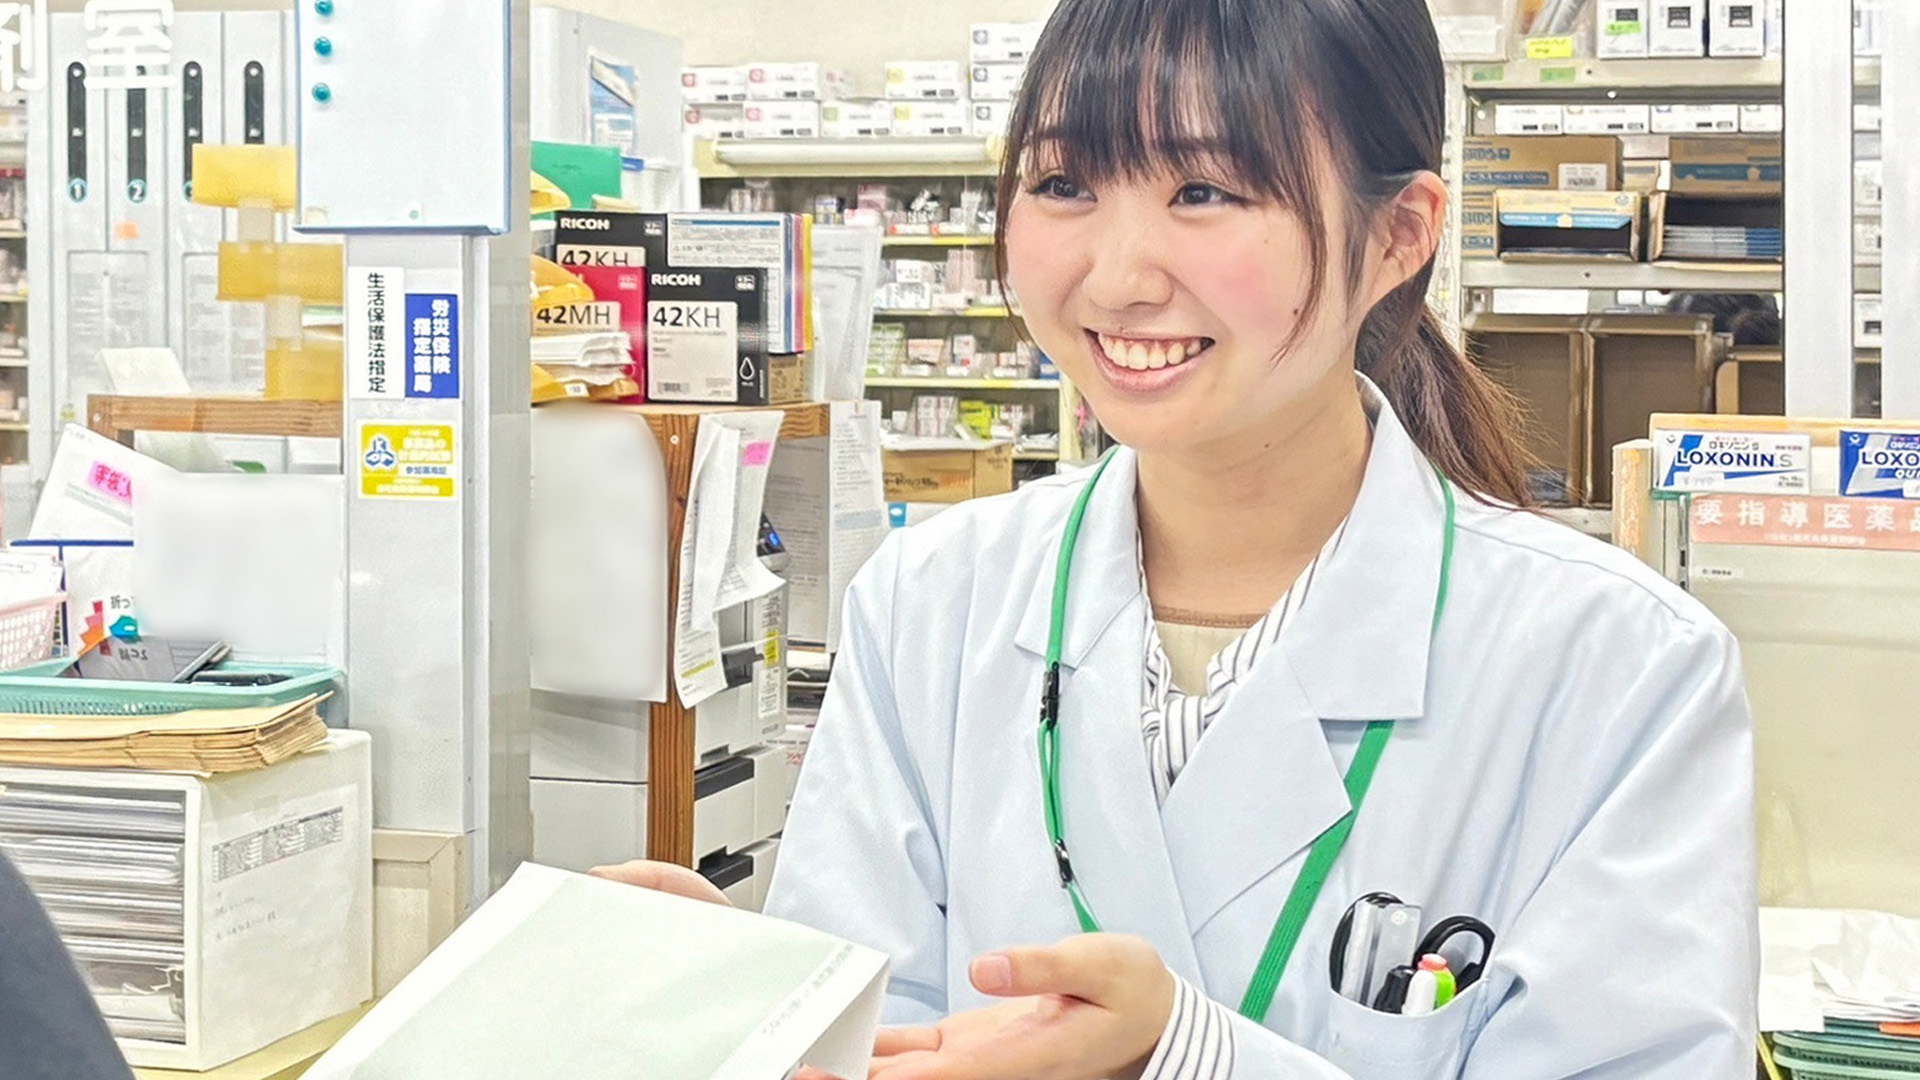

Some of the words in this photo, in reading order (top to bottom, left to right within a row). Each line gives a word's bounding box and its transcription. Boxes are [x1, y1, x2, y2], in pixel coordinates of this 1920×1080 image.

[560, 217, 610, 230] RICOH
[561, 250, 628, 266] 42KH
[651, 273, 701, 286] RICOH
[536, 304, 611, 325] 42MH
[653, 306, 720, 327] 42KH
[367, 272, 386, 393] 生活保護法指定
[431, 299, 451, 374] 労災保険
[413, 317, 432, 393] 指定薬局
[1677, 450, 1775, 467] LOXONIN
[1779, 453, 1793, 468] S
[1862, 451, 1920, 467] LOXO
